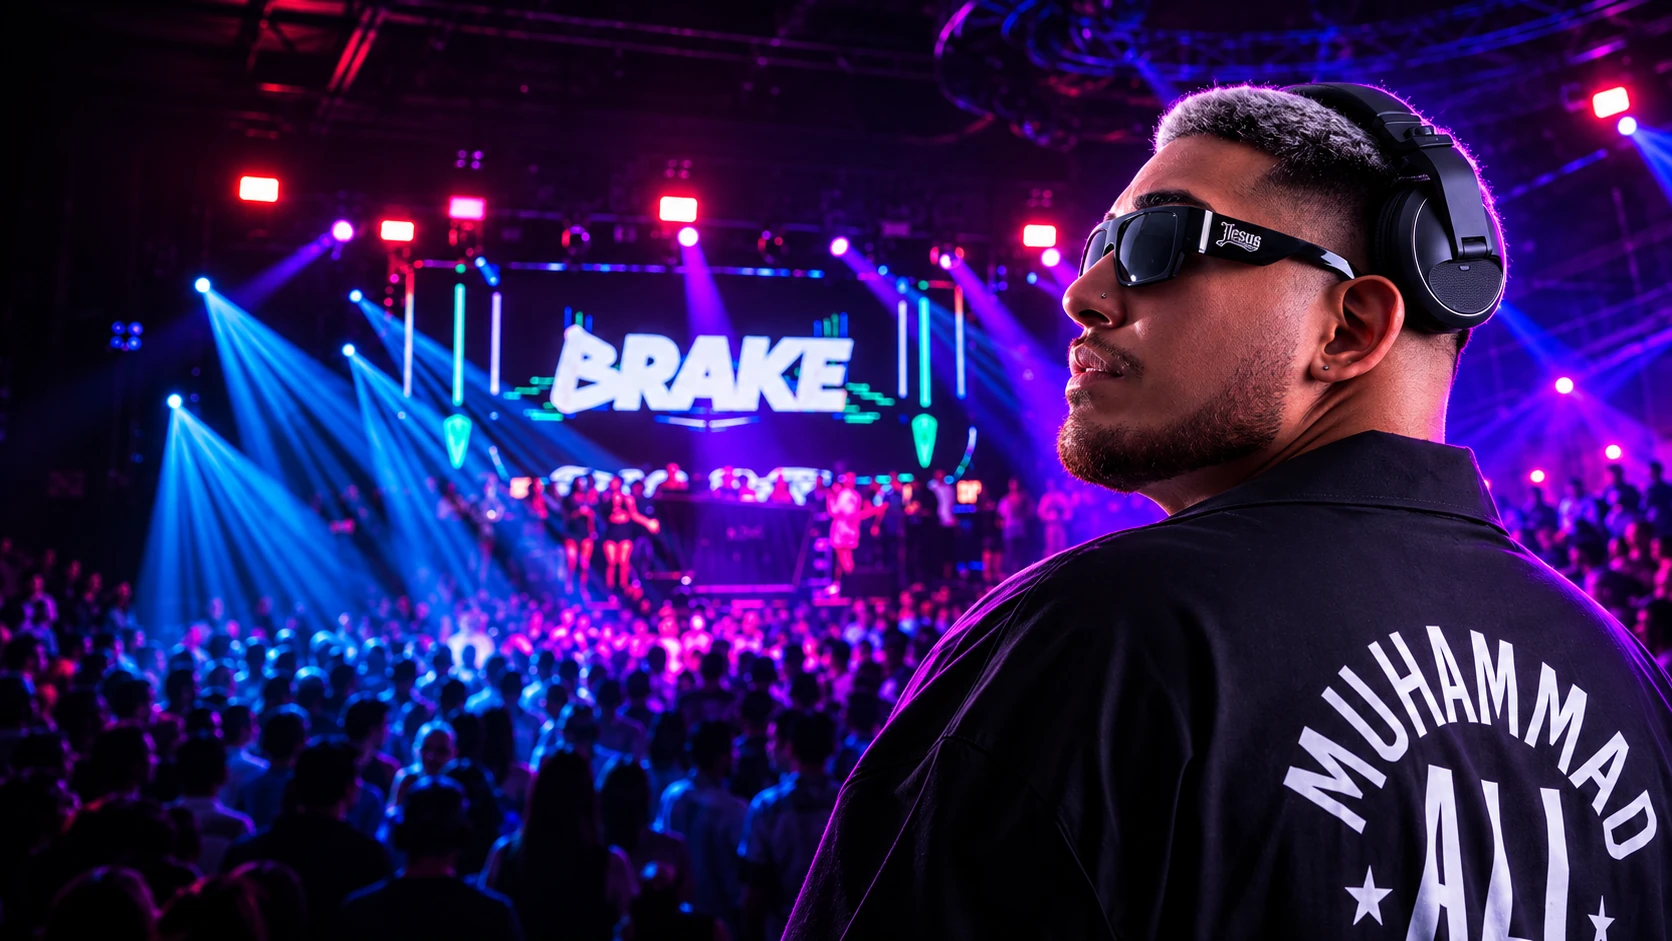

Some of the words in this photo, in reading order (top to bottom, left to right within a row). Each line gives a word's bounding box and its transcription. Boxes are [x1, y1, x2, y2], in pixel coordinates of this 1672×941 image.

[1216, 221, 1262, 252] Jesus
[549, 323, 854, 414] BRAKE
[1282, 625, 1658, 861] MUHAMMAD
[1405, 763, 1570, 941] ALI
